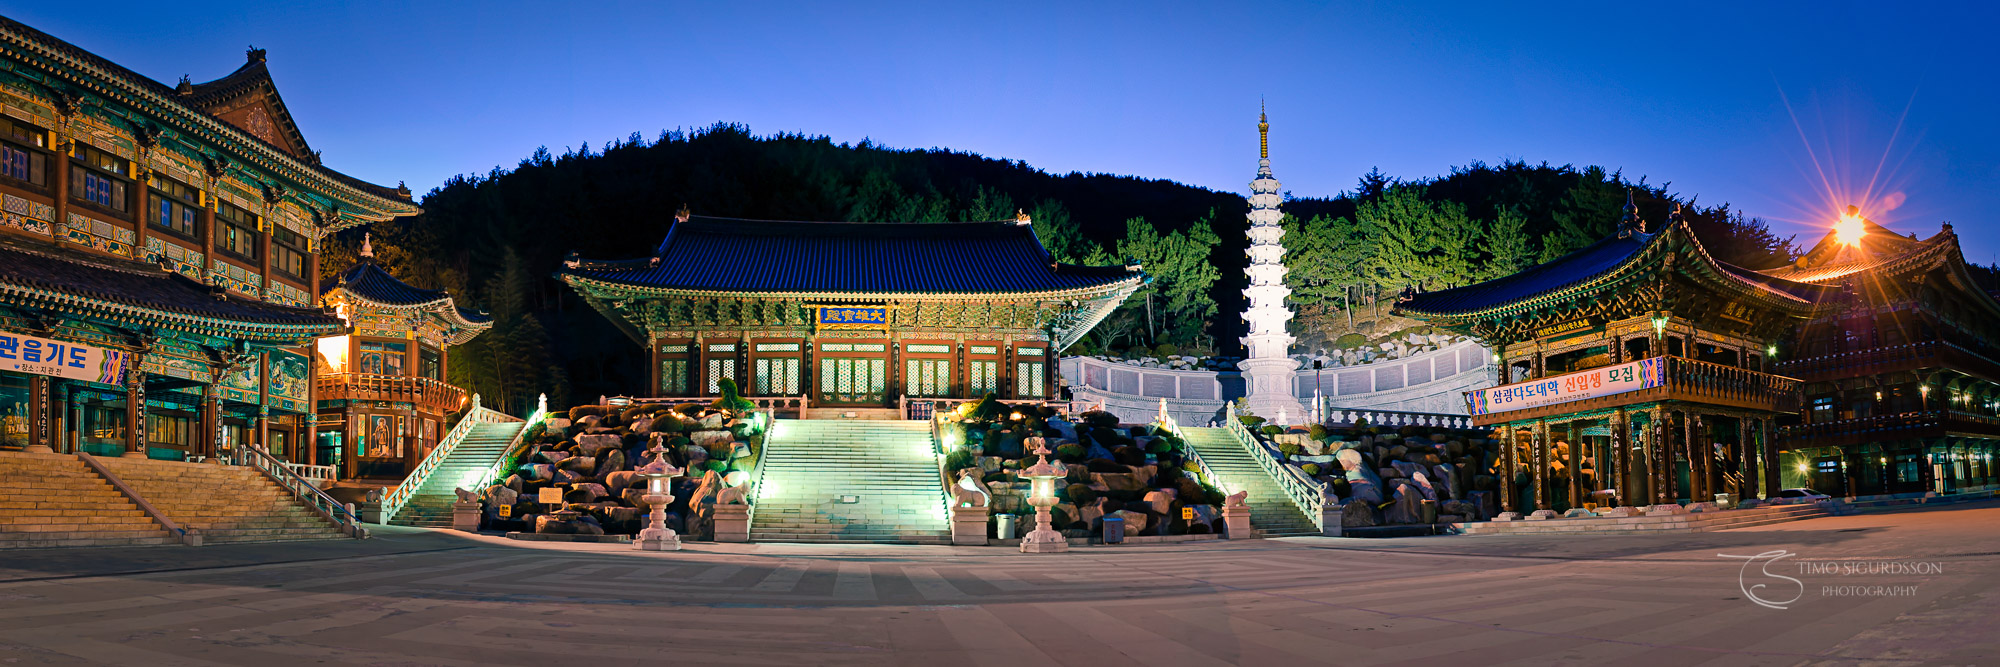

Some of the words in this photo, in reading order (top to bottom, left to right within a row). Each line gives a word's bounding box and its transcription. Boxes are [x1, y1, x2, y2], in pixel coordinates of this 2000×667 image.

[0, 335, 87, 369] 관음기도
[1493, 380, 1559, 404] 삼광다도대학
[1564, 371, 1601, 393] 신입생
[1608, 365, 1634, 383] 모집
